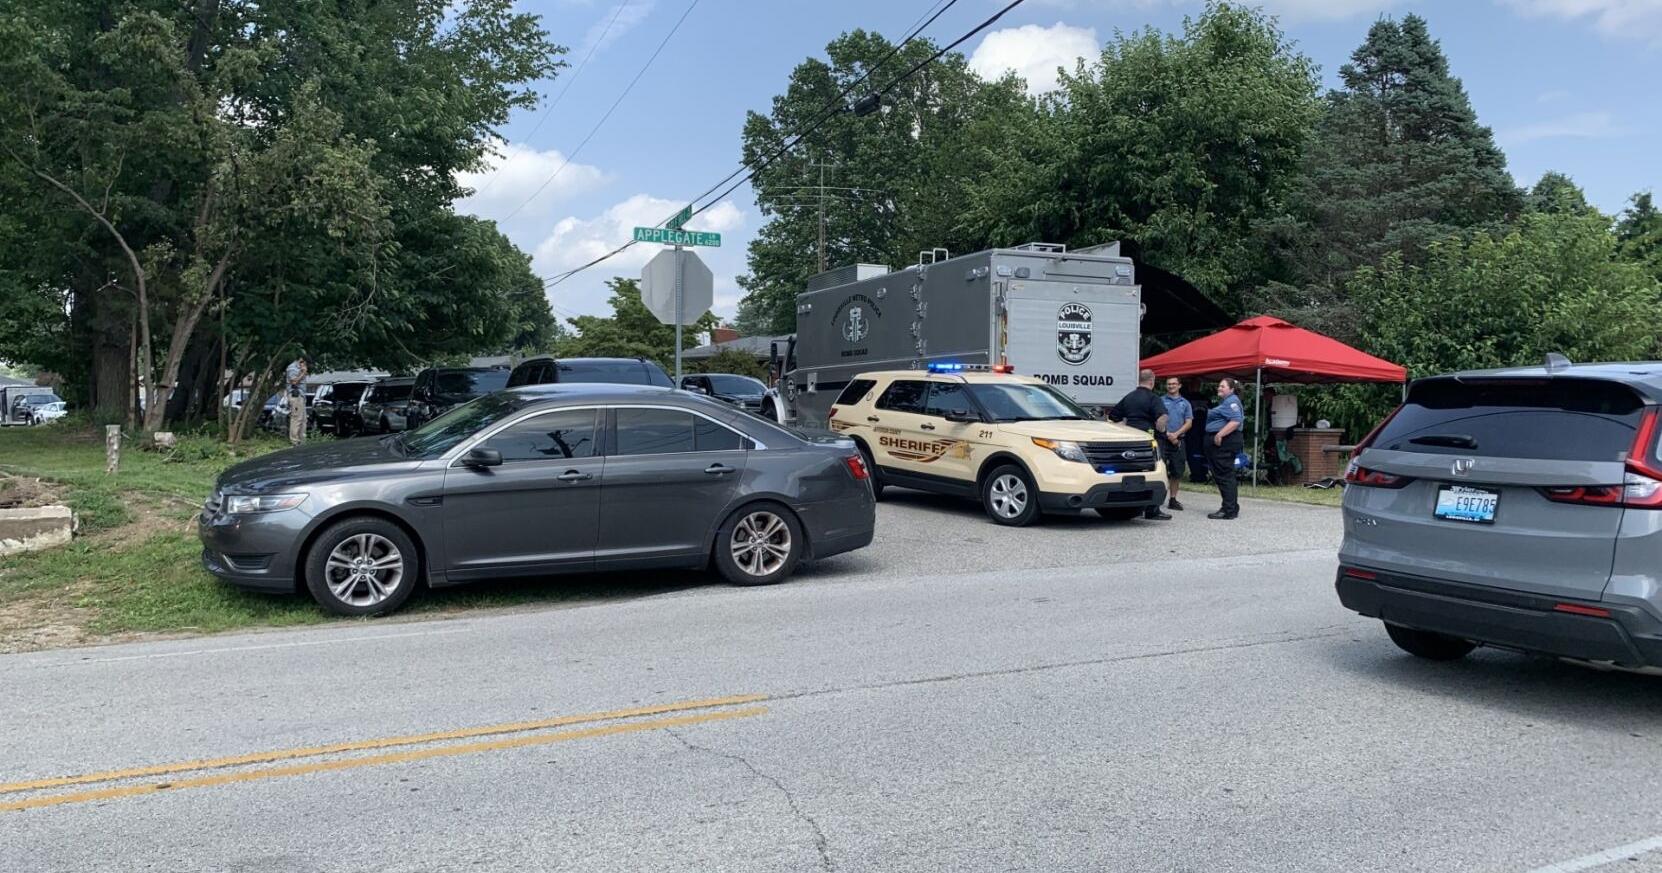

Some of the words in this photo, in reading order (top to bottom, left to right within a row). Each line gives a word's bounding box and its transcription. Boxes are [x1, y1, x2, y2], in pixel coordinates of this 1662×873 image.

[637, 229, 703, 245] APPLEGATE
[1060, 306, 1090, 319] POLICE
[1059, 322, 1091, 330] LOUISVILLE
[1073, 375, 1114, 386] SQUAD
[979, 430, 993, 439] 211
[880, 436, 941, 453] SHERIFF
[1456, 497, 1496, 514] E9E785
